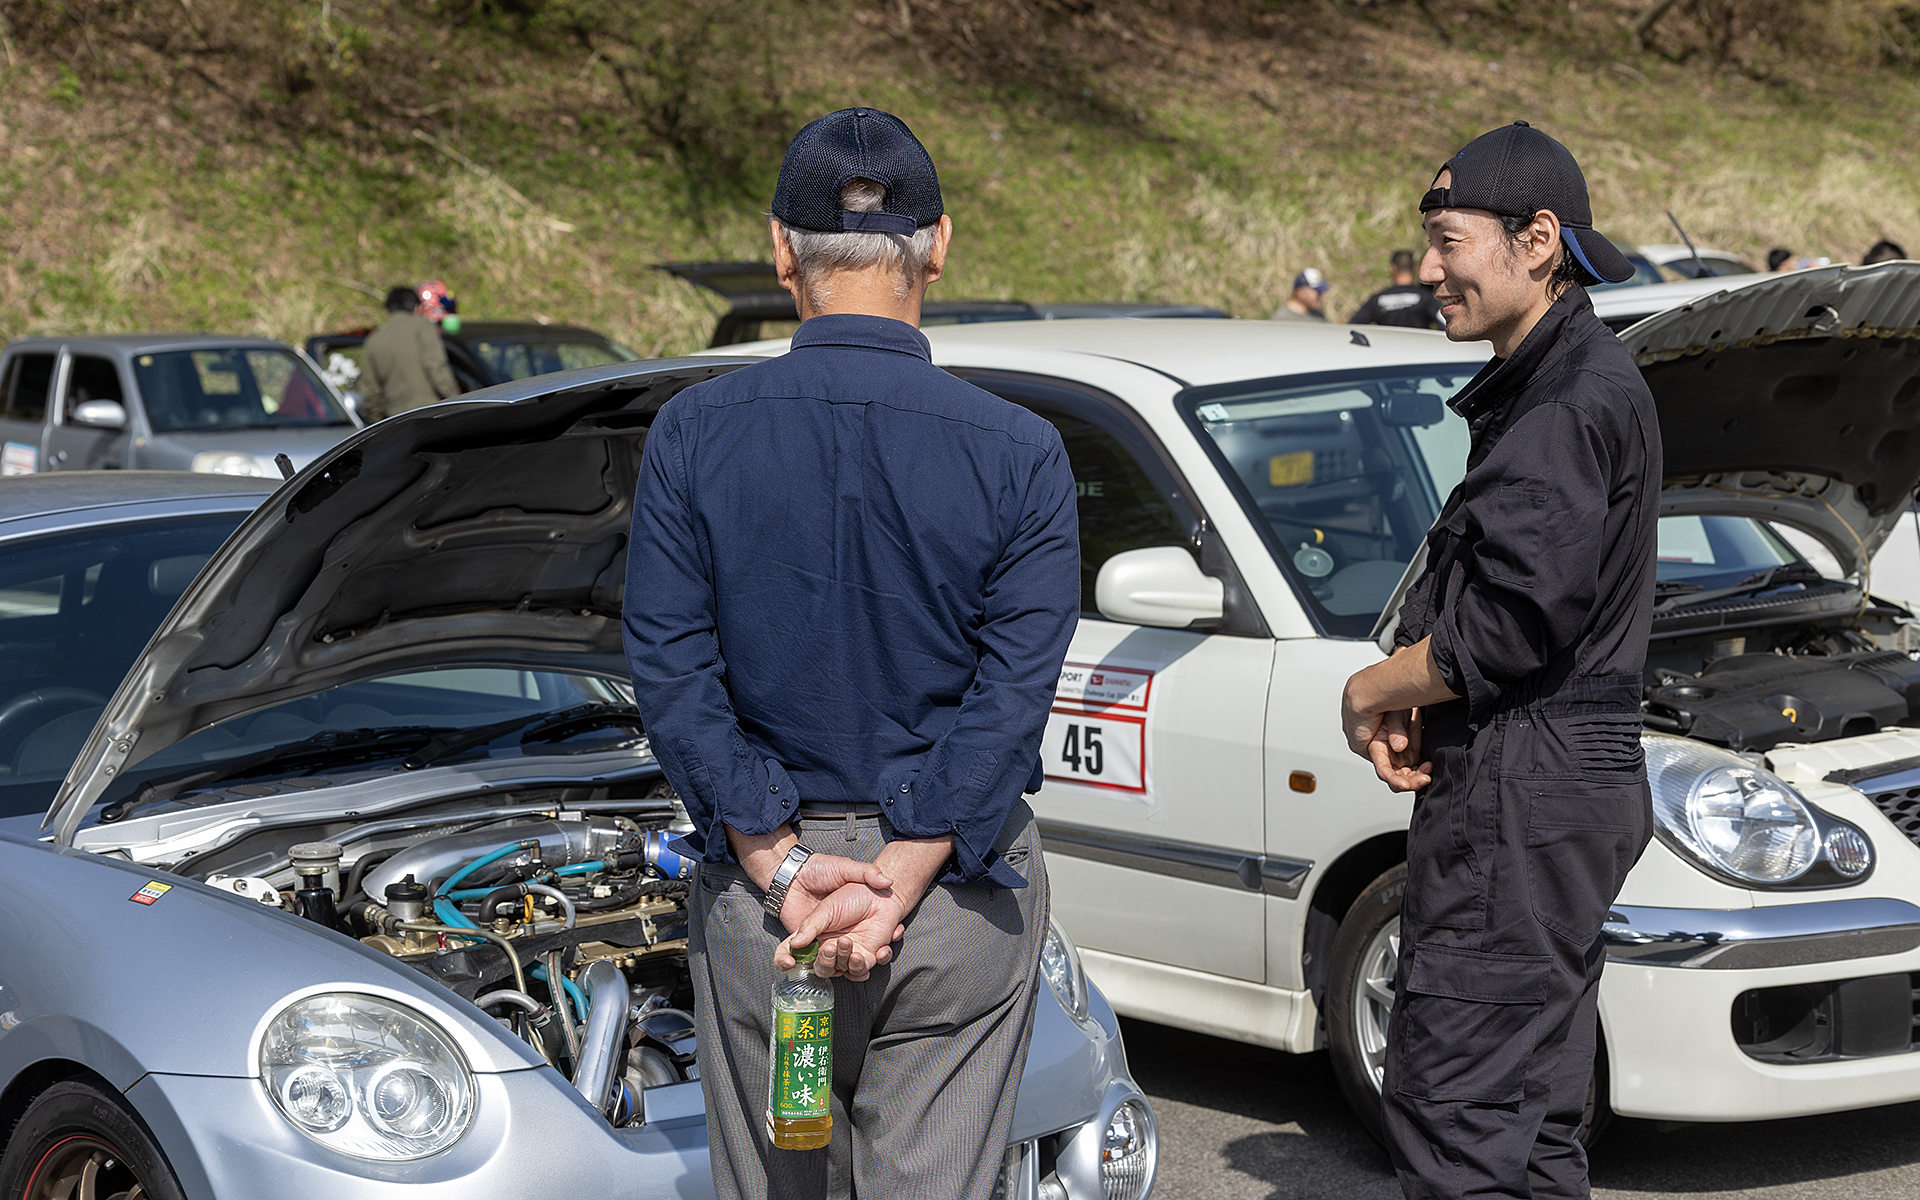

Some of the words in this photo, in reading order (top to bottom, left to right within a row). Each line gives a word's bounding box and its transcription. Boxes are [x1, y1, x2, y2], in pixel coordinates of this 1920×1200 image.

[1062, 724, 1103, 775] 45
[797, 1016, 814, 1039] 茶
[819, 1016, 829, 1037] 京都
[792, 1043, 817, 1107] 濃い味
[818, 1045, 828, 1087] 伊右衛門
